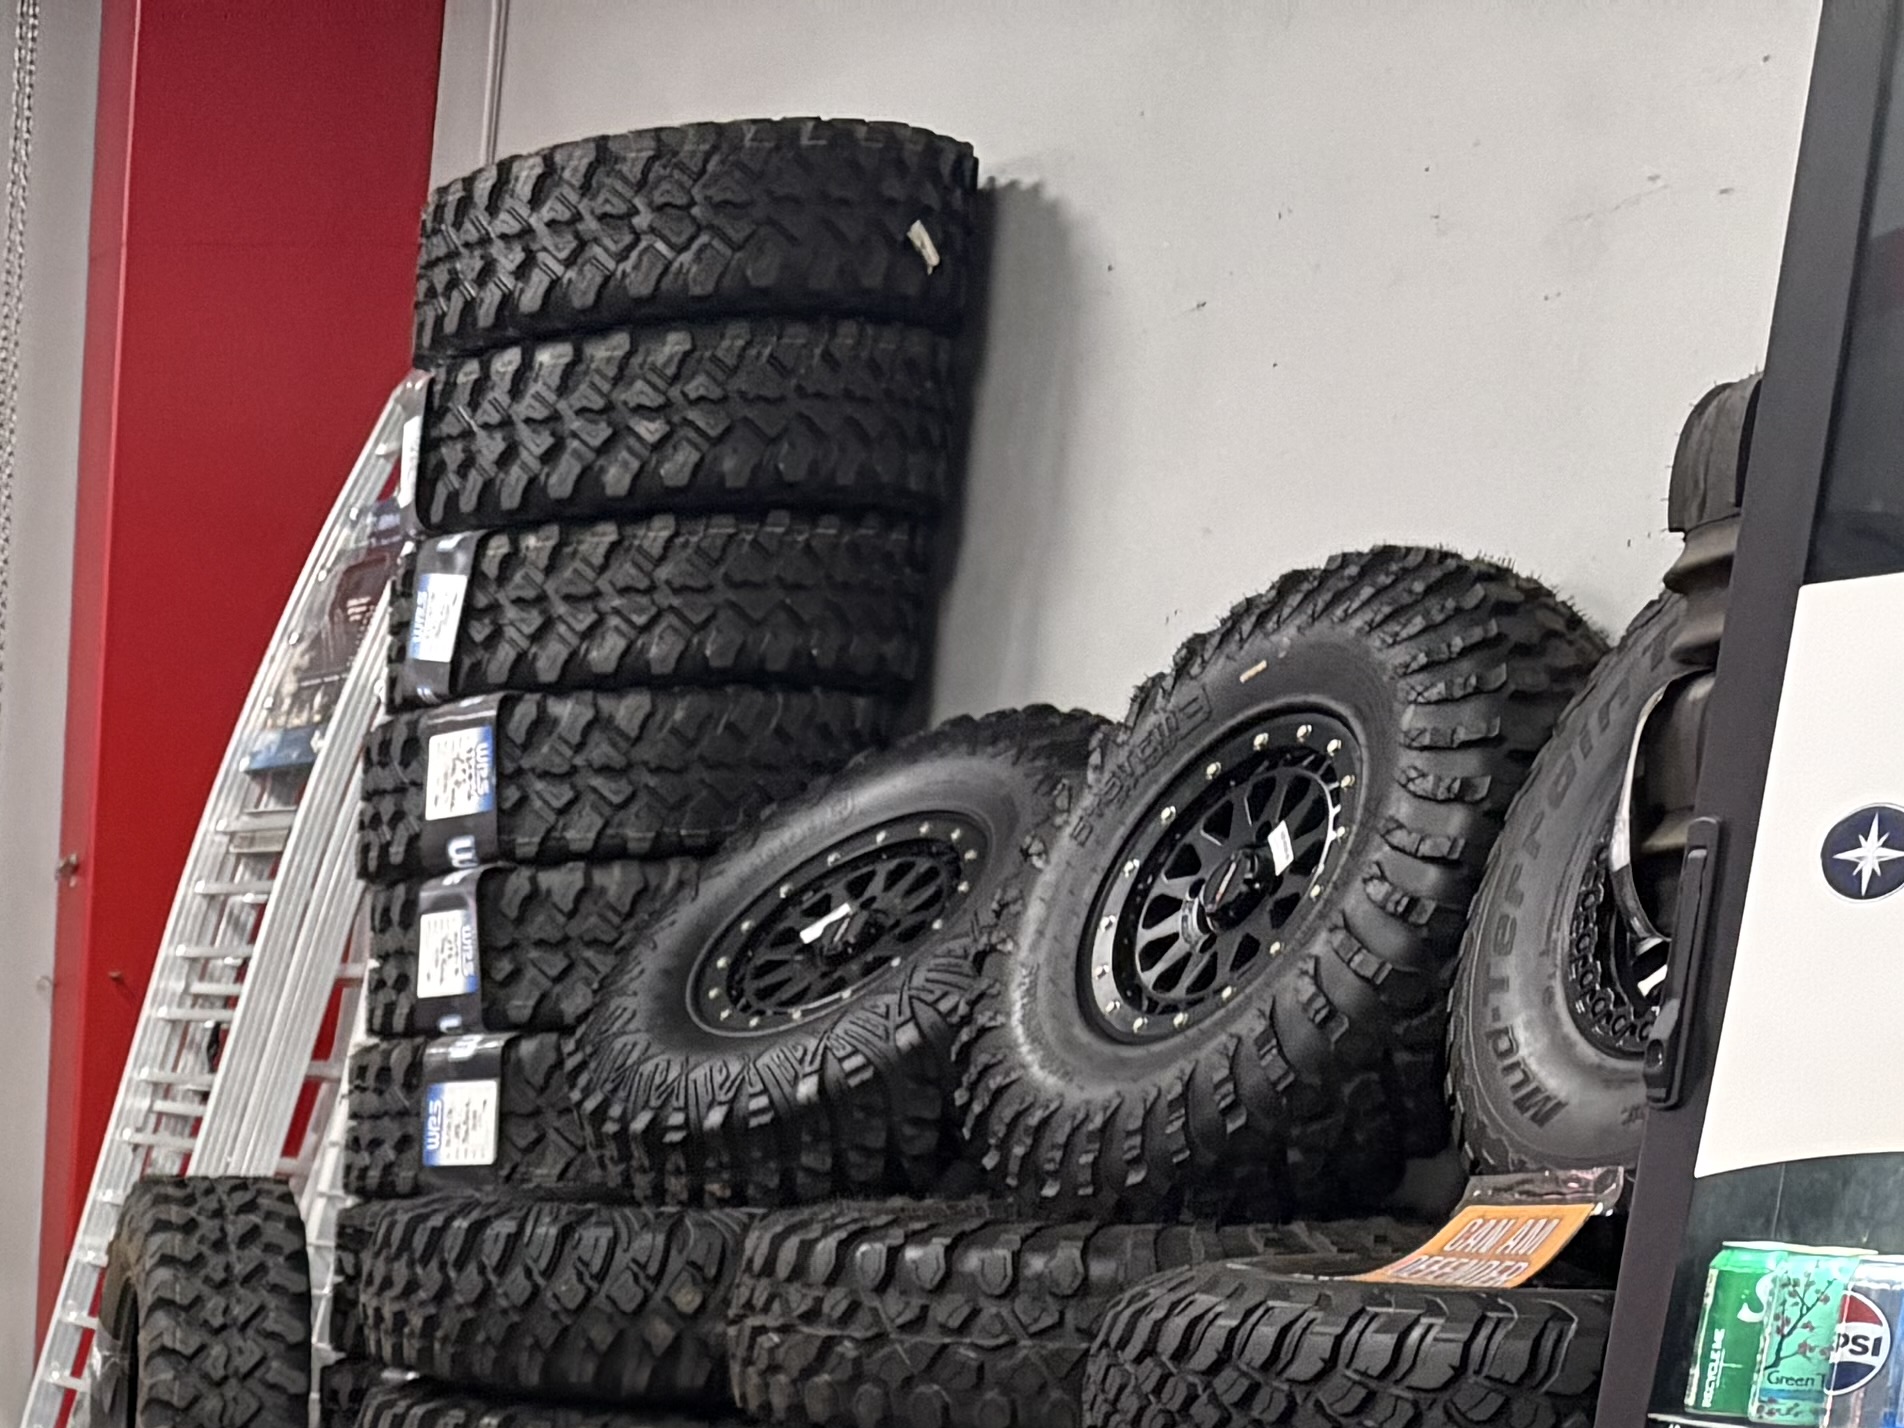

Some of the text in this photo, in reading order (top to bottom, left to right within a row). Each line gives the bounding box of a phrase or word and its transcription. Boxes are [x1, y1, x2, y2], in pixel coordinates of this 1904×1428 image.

[426, 1099, 443, 1151] WPS
[1444, 1218, 1561, 1254] CAN AM
[1837, 1333, 1883, 1357] PSI
[1767, 1371, 1815, 1387] Green
